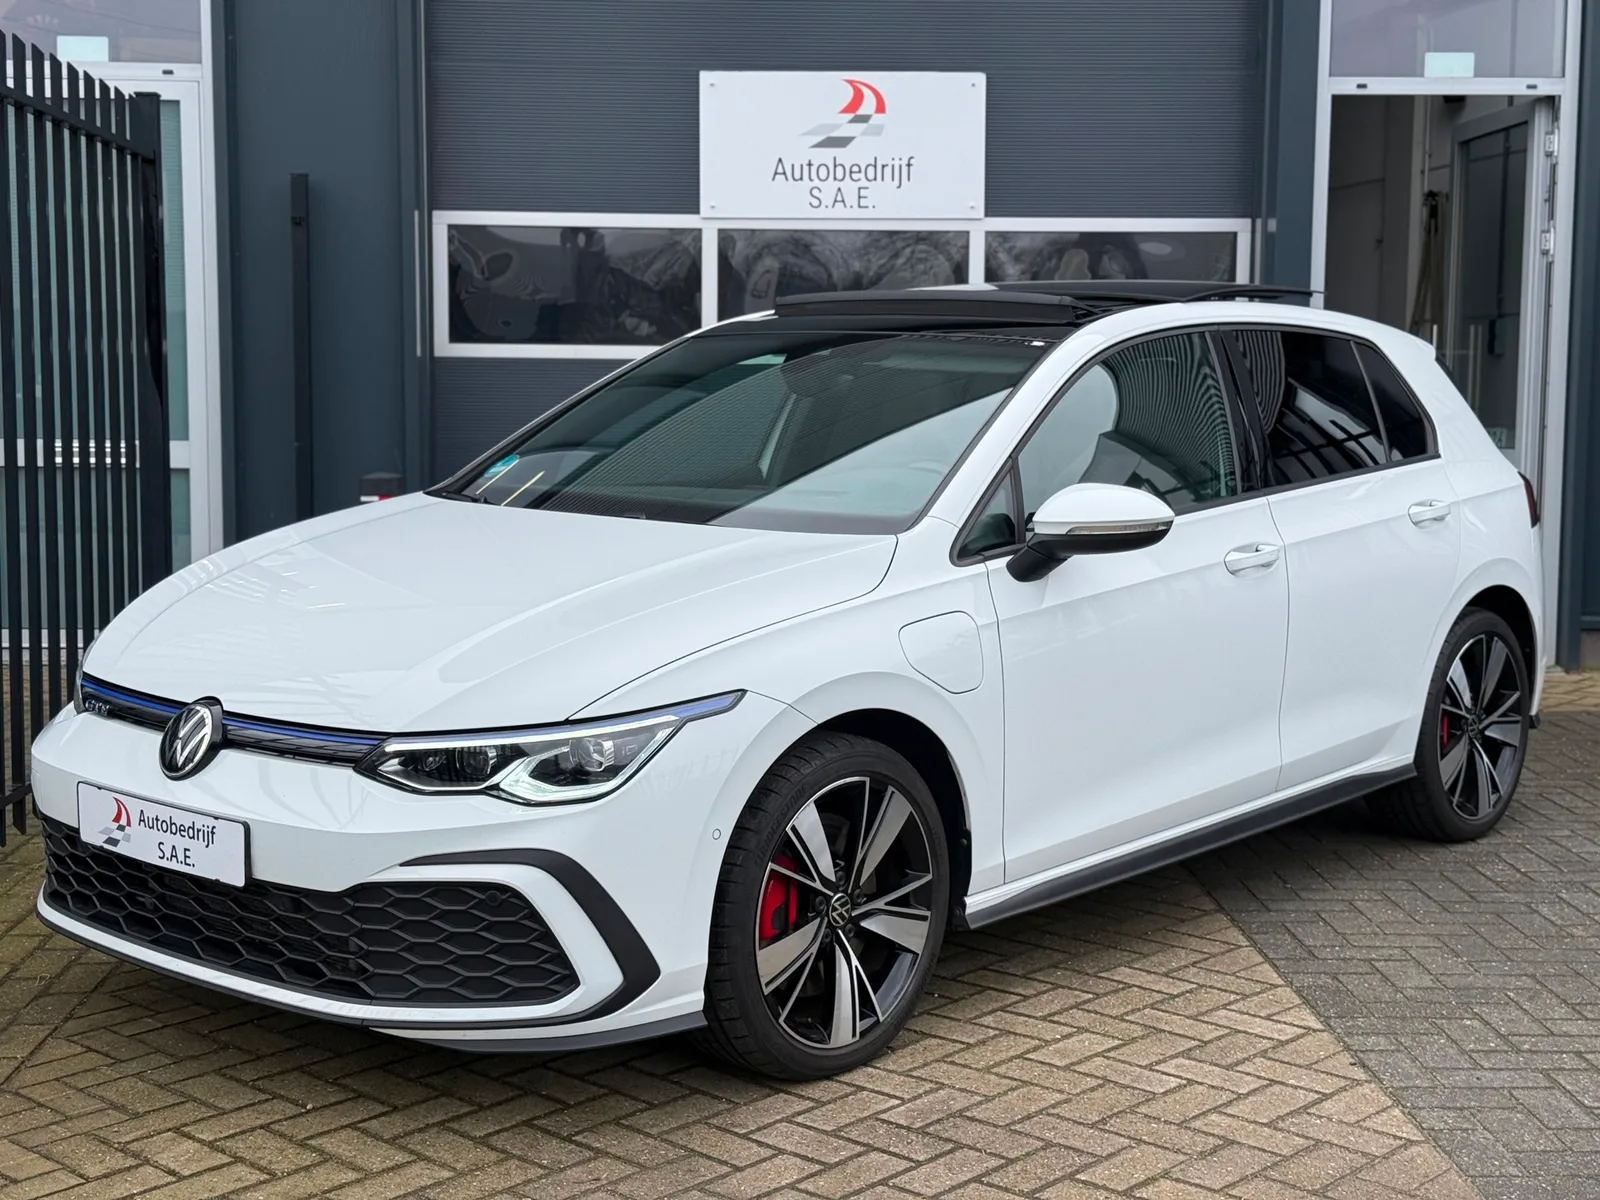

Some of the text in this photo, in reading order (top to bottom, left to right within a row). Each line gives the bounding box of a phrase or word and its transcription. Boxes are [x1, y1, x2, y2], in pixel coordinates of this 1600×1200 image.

[771, 156, 914, 189] Autobedrijf
[808, 187, 876, 209] S.A.E.
[137, 809, 217, 848] Autobedrijf
[157, 841, 196, 868] S.A.E.
